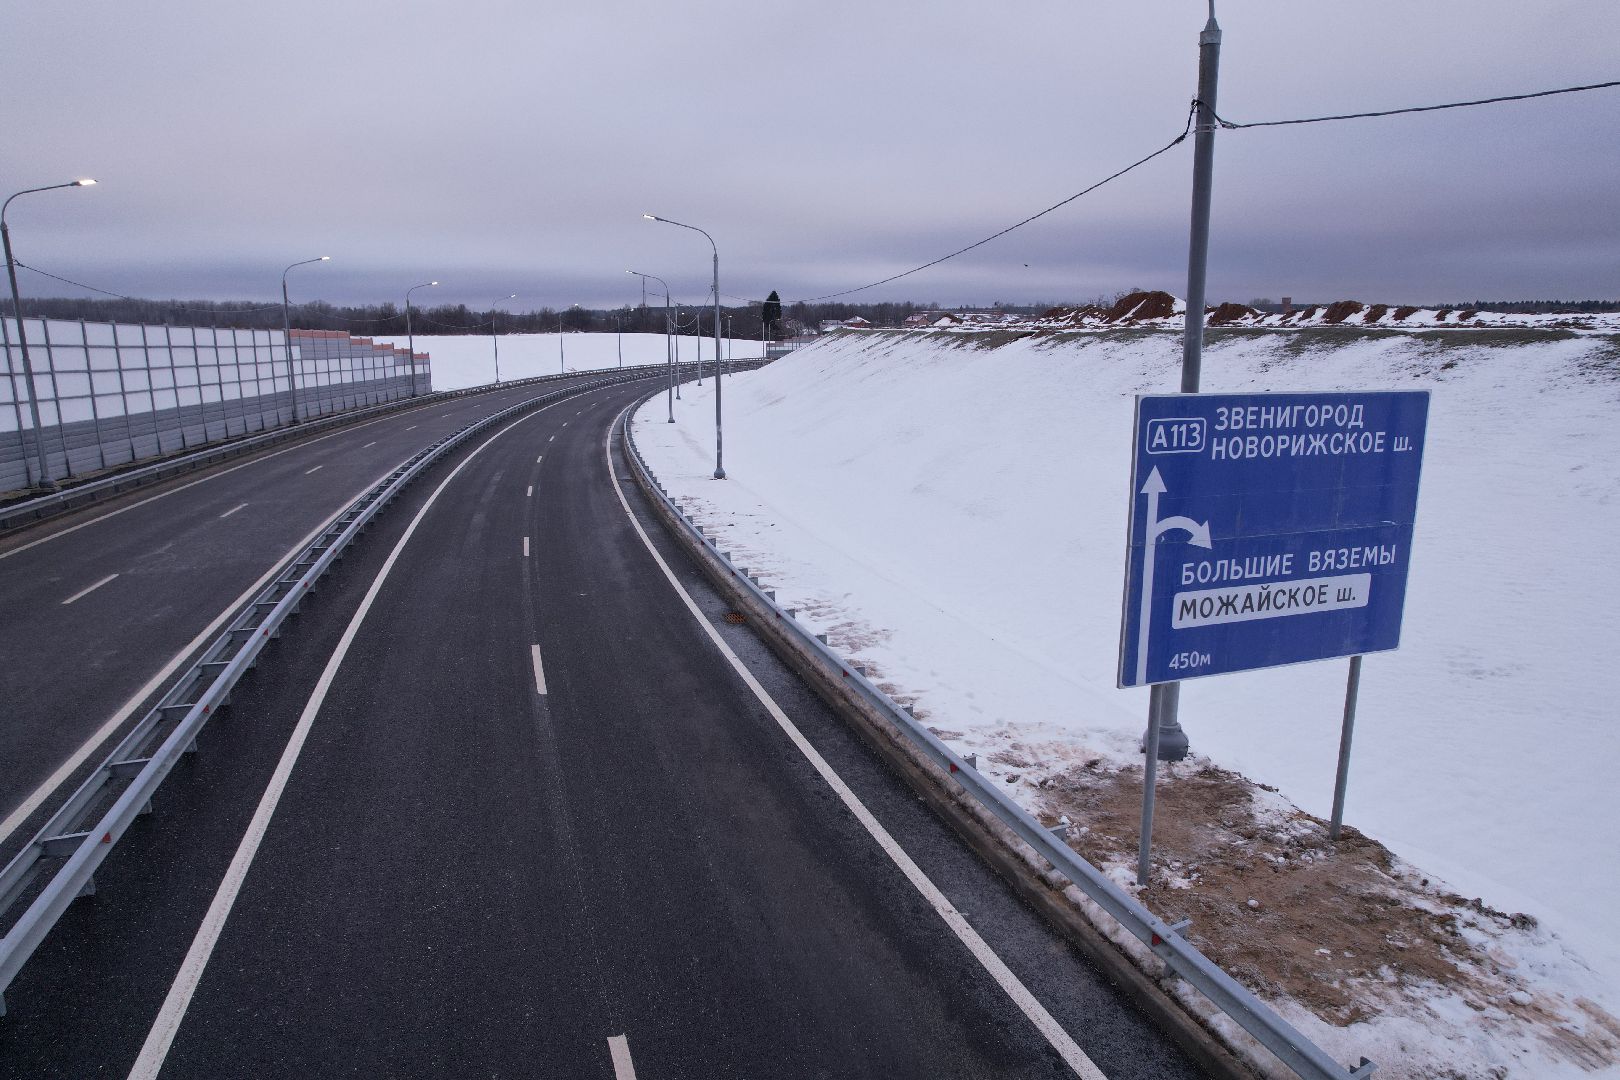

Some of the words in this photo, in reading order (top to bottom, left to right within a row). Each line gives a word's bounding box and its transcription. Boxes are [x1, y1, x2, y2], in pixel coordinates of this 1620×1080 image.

[1214, 404, 1364, 431] ЗВЕНИГОРОД
[1211, 431, 1386, 461] НОВОРИЖСКОЕ
[1393, 436, 1413, 452] ш.
[1181, 553, 1294, 585] БОЛЬШИЕ
[1308, 544, 1396, 573] ВЯЗЕМЫ
[1178, 584, 1329, 621] МОЖАЙСКОЕ
[1336, 587, 1356, 603] ш.
